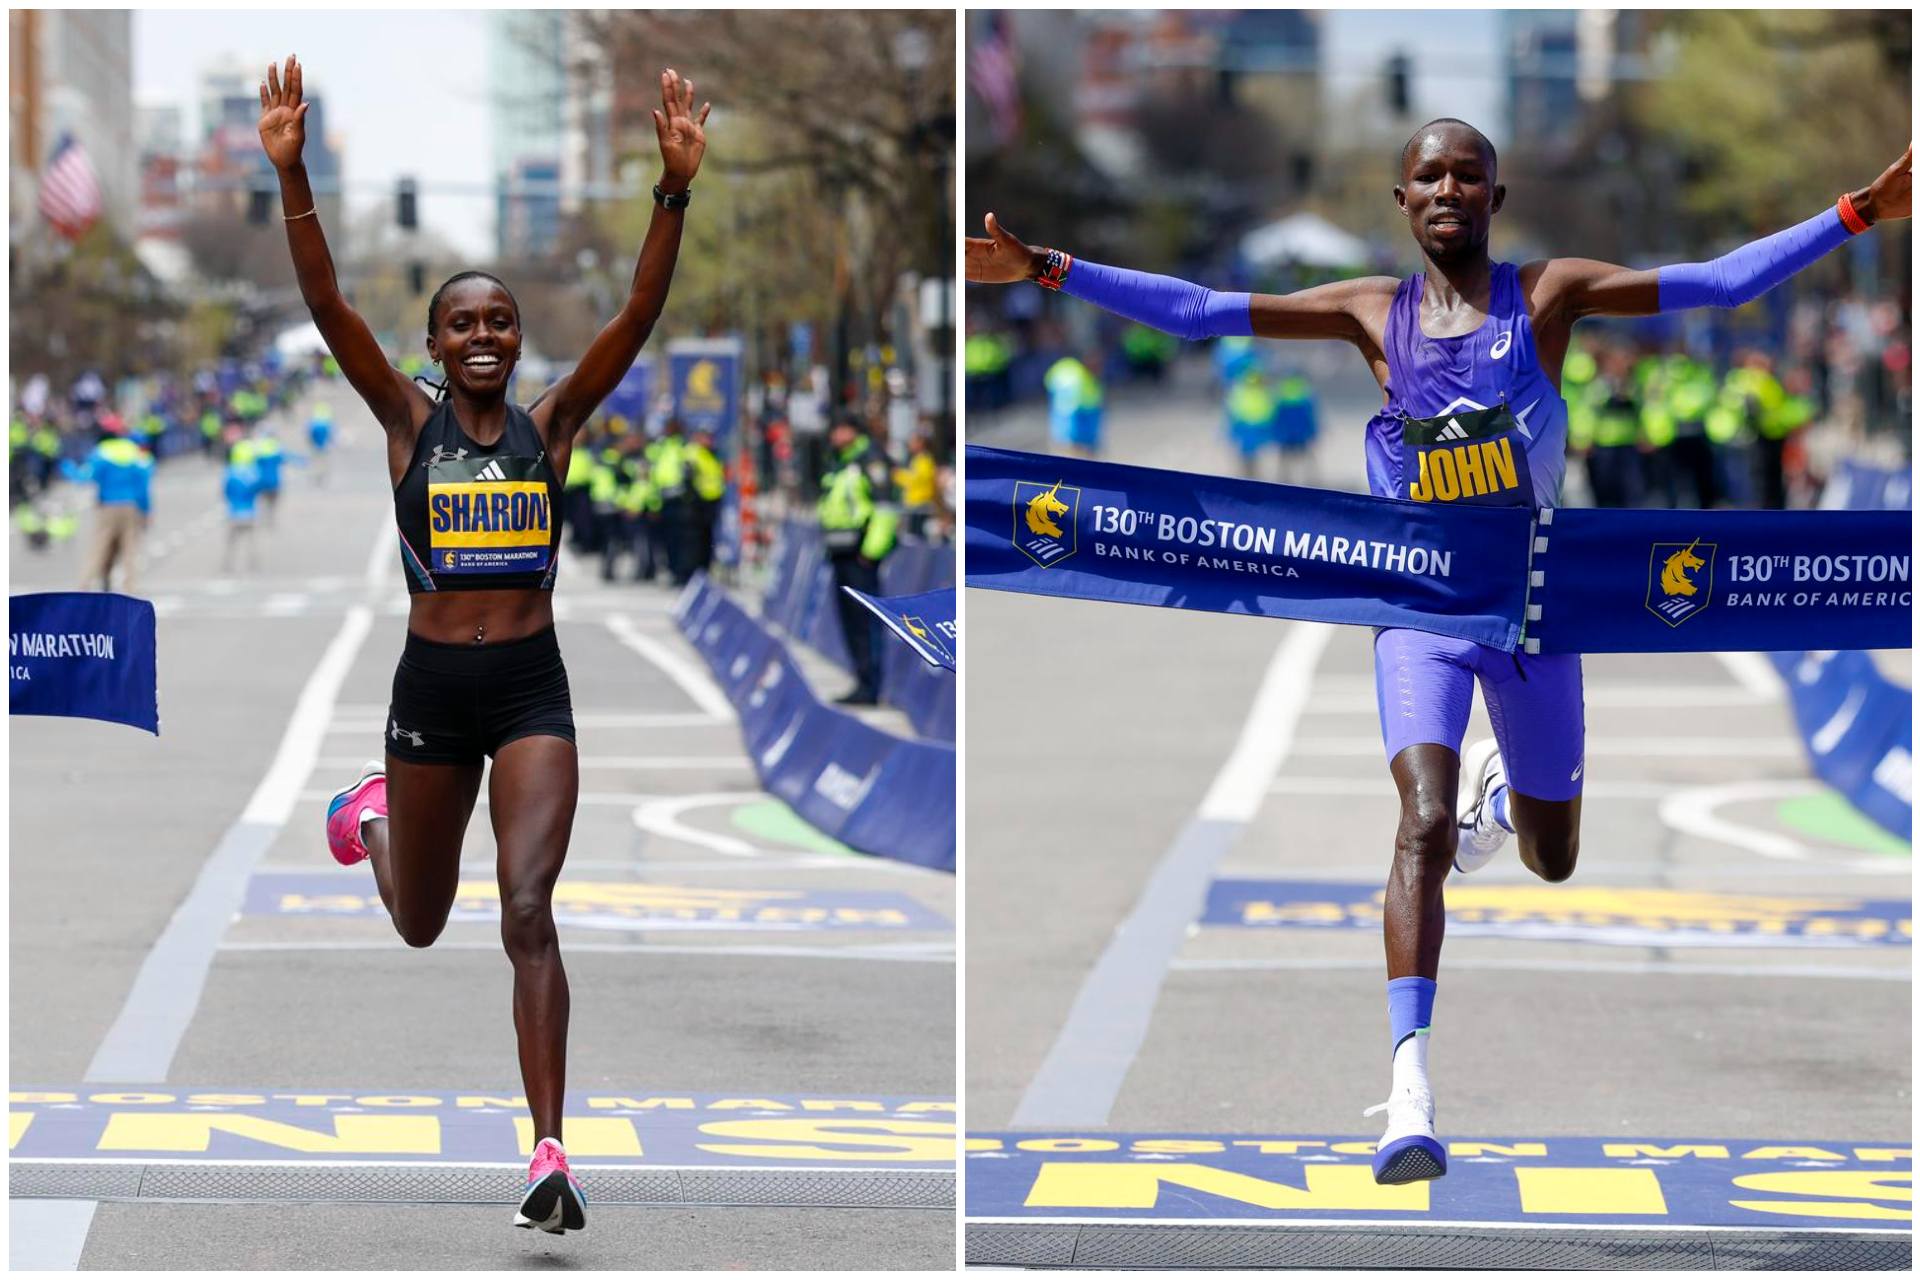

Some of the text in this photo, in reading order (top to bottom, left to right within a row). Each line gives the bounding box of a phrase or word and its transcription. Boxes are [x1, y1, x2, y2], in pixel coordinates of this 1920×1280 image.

[1409, 437, 1519, 502] JOHN
[431, 491, 548, 533] SHARON
[475, 552, 503, 561] BOSTON
[504, 551, 538, 560] MARATHON
[1093, 505, 1451, 577] 130TH BOSTON MARATHON
[1095, 542, 1299, 578] BANK OF AMERICA
[1728, 554, 1910, 582] 130TH BOSTON
[1727, 591, 1912, 607] BANK OF AMERIC
[22, 632, 115, 660] MARATHON
[9, 1111, 956, 1161] NIS
